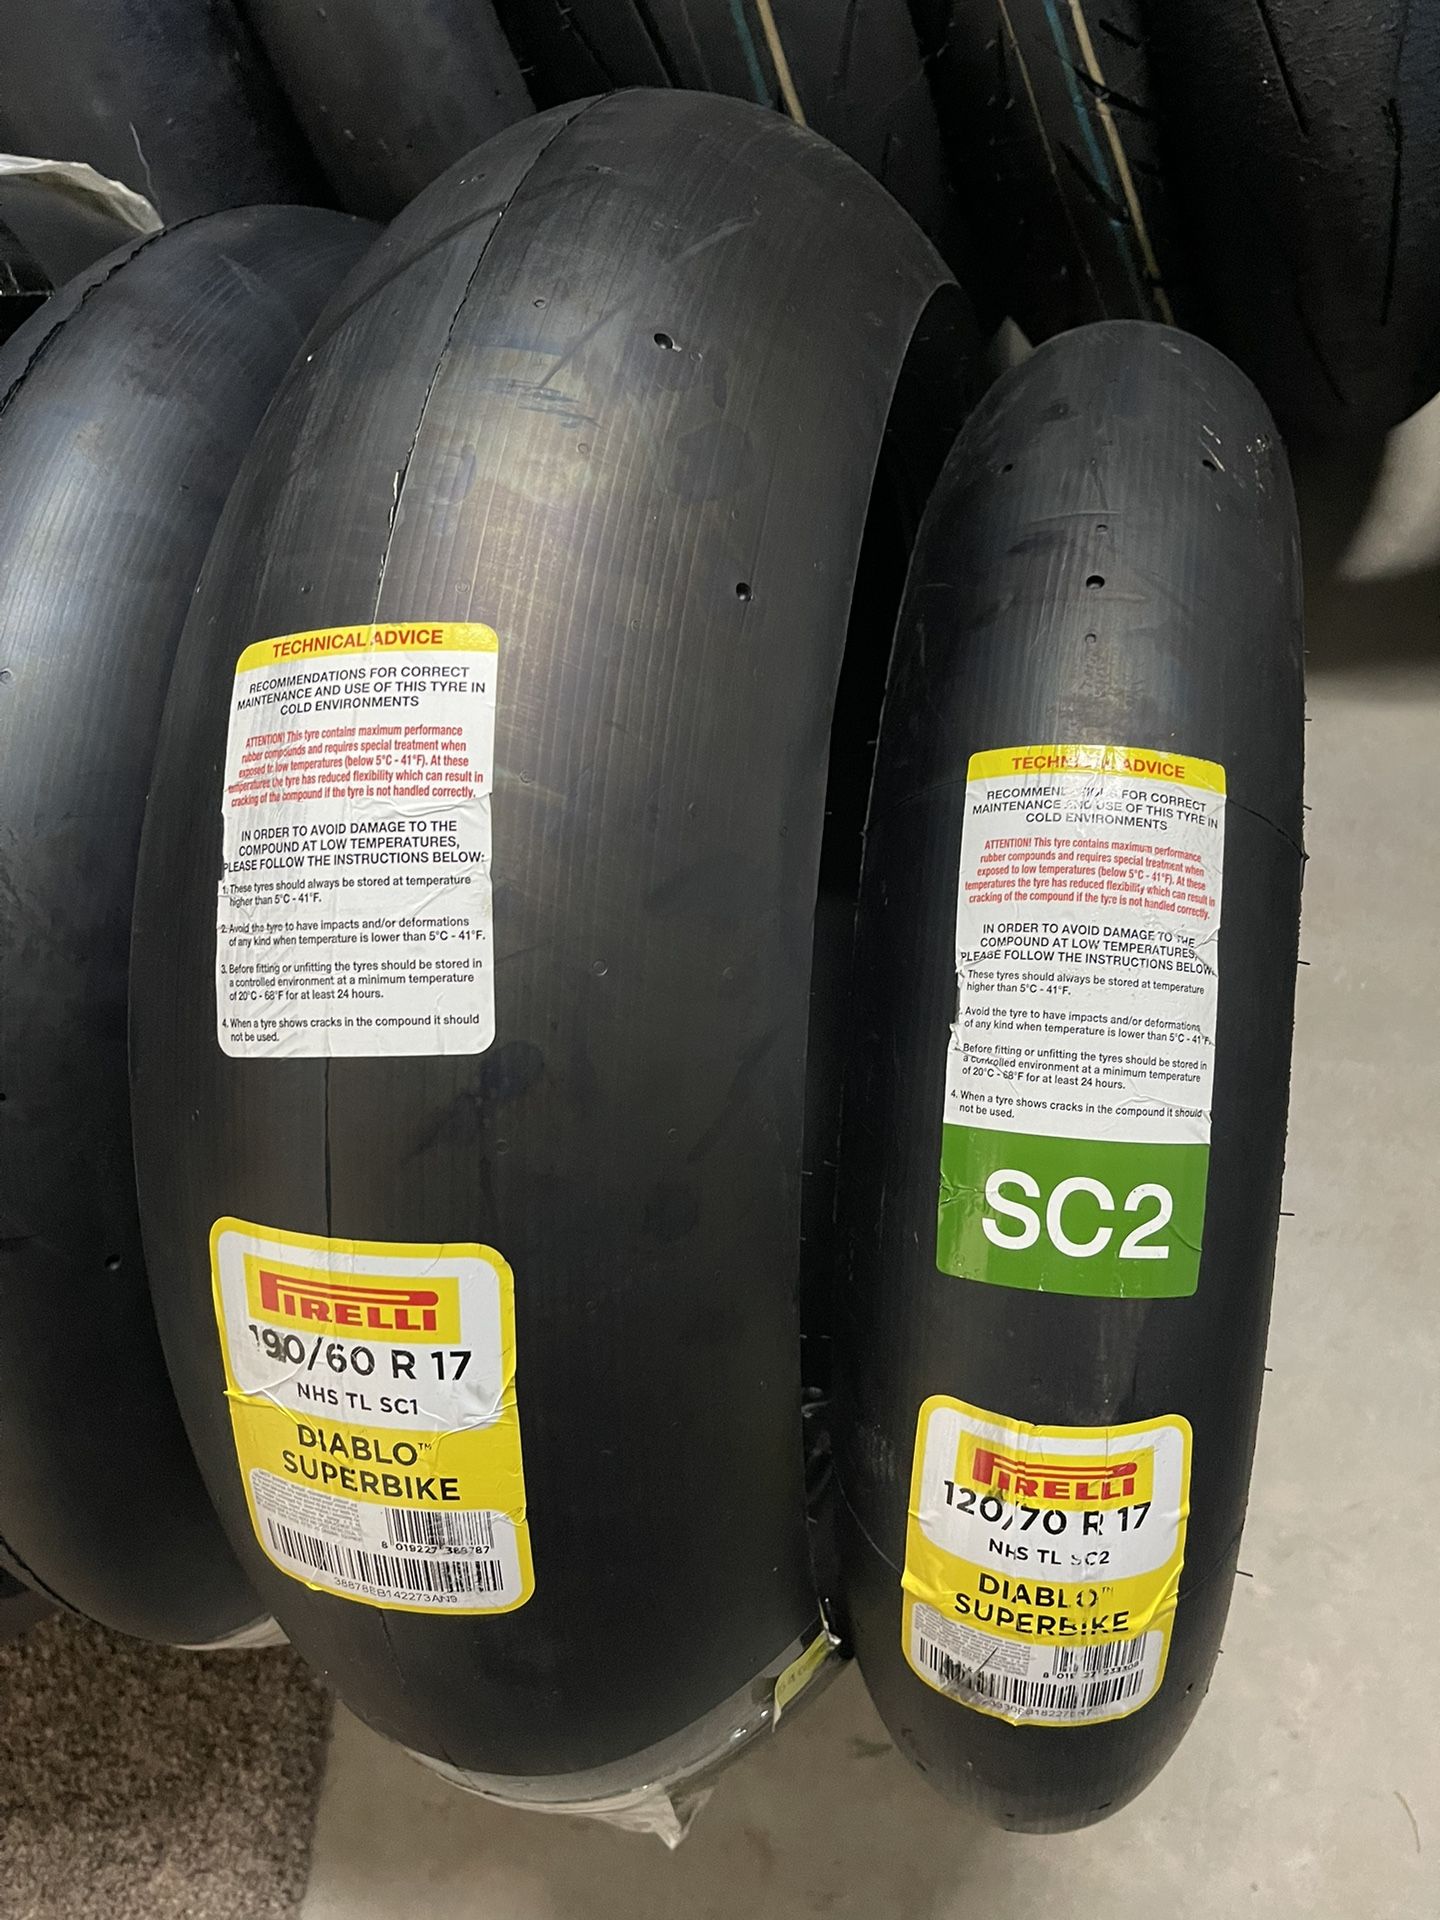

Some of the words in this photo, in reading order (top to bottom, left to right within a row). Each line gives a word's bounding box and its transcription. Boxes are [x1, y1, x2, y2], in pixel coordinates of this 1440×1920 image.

[273, 633, 366, 658] TECHNICAL
[371, 630, 443, 646] ADVICE
[249, 668, 366, 693] RECOMMENDATIONS
[370, 668, 397, 678] FOR
[401, 667, 469, 677] CORRECT
[237, 688, 312, 711] MAINTENANCE
[315, 685, 340, 697] AND
[345, 684, 369, 694] USE
[373, 682, 392, 692] OF
[395, 682, 426, 692] THIS
[431, 681, 467, 692] TYRE
[471, 683, 485, 692] IN
[280, 700, 312, 715] COLD
[315, 696, 419, 711] ENVIRONMENTS
[1124, 759, 1184, 778] ADVICE
[1122, 790, 1147, 800] FOR
[1151, 793, 1206, 812] CORRECT
[973, 800, 1060, 814] MAINTENANCE
[1126, 804, 1142, 813] OF
[1146, 805, 1174, 818] THIS
[1177, 810, 1205, 825] TYRE
[1208, 818, 1218, 829] IN
[1026, 813, 1061, 822] COLD
[1066, 812, 1168, 830] ENVIRONMENTS
[241, 831, 251, 841] IN
[254, 827, 289, 840] ORDER
[293, 825, 307, 836] TO
[311, 824, 346, 836] AVOID
[350, 822, 405, 834] DAMAGE
[409, 821, 426, 832] TO
[431, 821, 457, 831] THE
[239, 840, 299, 856] COMPOUND
[302, 840, 317, 850] AT
[320, 839, 347, 849] LOW
[351, 836, 460, 849] TEMPERATURES,
[985, 839, 1031, 849] ATTENTION!
[1035, 838, 1051, 847] This
[1054, 839, 1070, 848] tyre
[1072, 838, 1109, 849] contains
[1112, 840, 1152, 852] maximum
[1155, 846, 1201, 862] performance
[224, 860, 257, 873] PLEASE
[260, 857, 304, 870] FOLLOW
[307, 855, 330, 866] THE
[334, 853, 428, 865] INSTRUCTIONS
[433, 851, 484, 863] BELOW:
[981, 852, 1005, 863] rubber
[1008, 851, 1055, 862] compounds
[1058, 851, 1073, 860] and
[1076, 852, 1111, 864] requires
[1114, 855, 1143, 866] special
[1146, 858, 1183, 870] treatment
[1185, 866, 1204, 876] when
[983, 924, 994, 933] IN
[998, 923, 1038, 933] ORDER
[1042, 923, 1058, 933] TO
[1062, 924, 1100, 936] AVOID
[1104, 926, 1154, 940] DAMAGE
[1158, 931, 1172, 942] TO
[1177, 935, 1195, 948] THE
[961, 951, 1001, 961] PLEASE
[1004, 949, 1054, 960] FOLLOW
[1058, 952, 1084, 963] THE
[1085, 954, 1173, 970] INSTRUCTIONS
[980, 937, 1049, 947] COMPOUND
[1052, 938, 1068, 947] AT
[1072, 938, 1100, 949] LOW
[1104, 941, 1198, 960] TEMPERATURES,
[221, 964, 227, 974] 3.
[229, 963, 254, 974] Before
[256, 963, 280, 975] fitting
[294, 962, 331, 974] unfitting
[335, 962, 350, 971] the
[353, 962, 378, 973] tyres
[381, 960, 416, 970] should
[419, 960, 432, 969] be
[435, 960, 469, 969] stored
[472, 959, 482, 968] in
[229, 980, 234, 988] a
[235, 977, 275, 988] controlled
[278, 975, 334, 986] environment
[337, 975, 346, 984] at
[358, 974, 405, 984] minimum
[409, 973, 474, 985] temperature
[967, 982, 994, 992] higher
[997, 983, 1017, 992] than
[968, 970, 994, 979] These
[997, 971, 1019, 981] tyres
[1022, 972, 1054, 981] should
[1057, 974, 1090, 986] always
[1094, 976, 1105, 984] be
[1108, 978, 1139, 987] stored
[1141, 980, 1150, 988] at
[1153, 982, 1204, 994] temperature
[229, 990, 237, 1001] of
[285, 990, 298, 999] for
[301, 990, 309, 999] at
[312, 989, 335, 999] least
[337, 989, 349, 998] 24
[352, 989, 383, 998] hours.
[222, 1019, 228, 1028] 4.
[230, 1018, 251, 1028] When
[254, 1020, 258, 1028] a
[260, 1019, 277, 1030] tyre
[279, 1018, 307, 1028] shows
[311, 1017, 342, 1027] cracks
[345, 1017, 353, 1026] in
[356, 1016, 372, 1026] the
[375, 1015, 431, 1027] compound
[434, 1015, 440, 1024] it
[443, 1014, 479, 1024] should
[231, 1032, 243, 1042] not
[245, 1031, 255, 1042] be
[256, 1031, 279, 1042] used.
[982, 1169, 1173, 1259] SC2
[260, 1271, 439, 1330] PIRELLI
[249, 1325, 375, 1376] 190/60
[392, 1349, 417, 1380] R
[431, 1351, 472, 1380] 17
[297, 1382, 338, 1406] NHS
[346, 1394, 372, 1410] TL
[382, 1399, 418, 1415] SC1
[282, 1450, 460, 1500] SUPERBIKE
[972, 1448, 1138, 1500] PIRELLI
[944, 1480, 1067, 1535] 120/70
[1082, 1510, 1104, 1536] R
[1117, 1502, 1151, 1532] 17
[381, 1541, 388, 1549] 8
[989, 1538, 1028, 1560] NHS
[1037, 1550, 1061, 1565] TL
[1071, 1551, 1110, 1566] SC2
[954, 1593, 1130, 1636] SUPERBIKE
